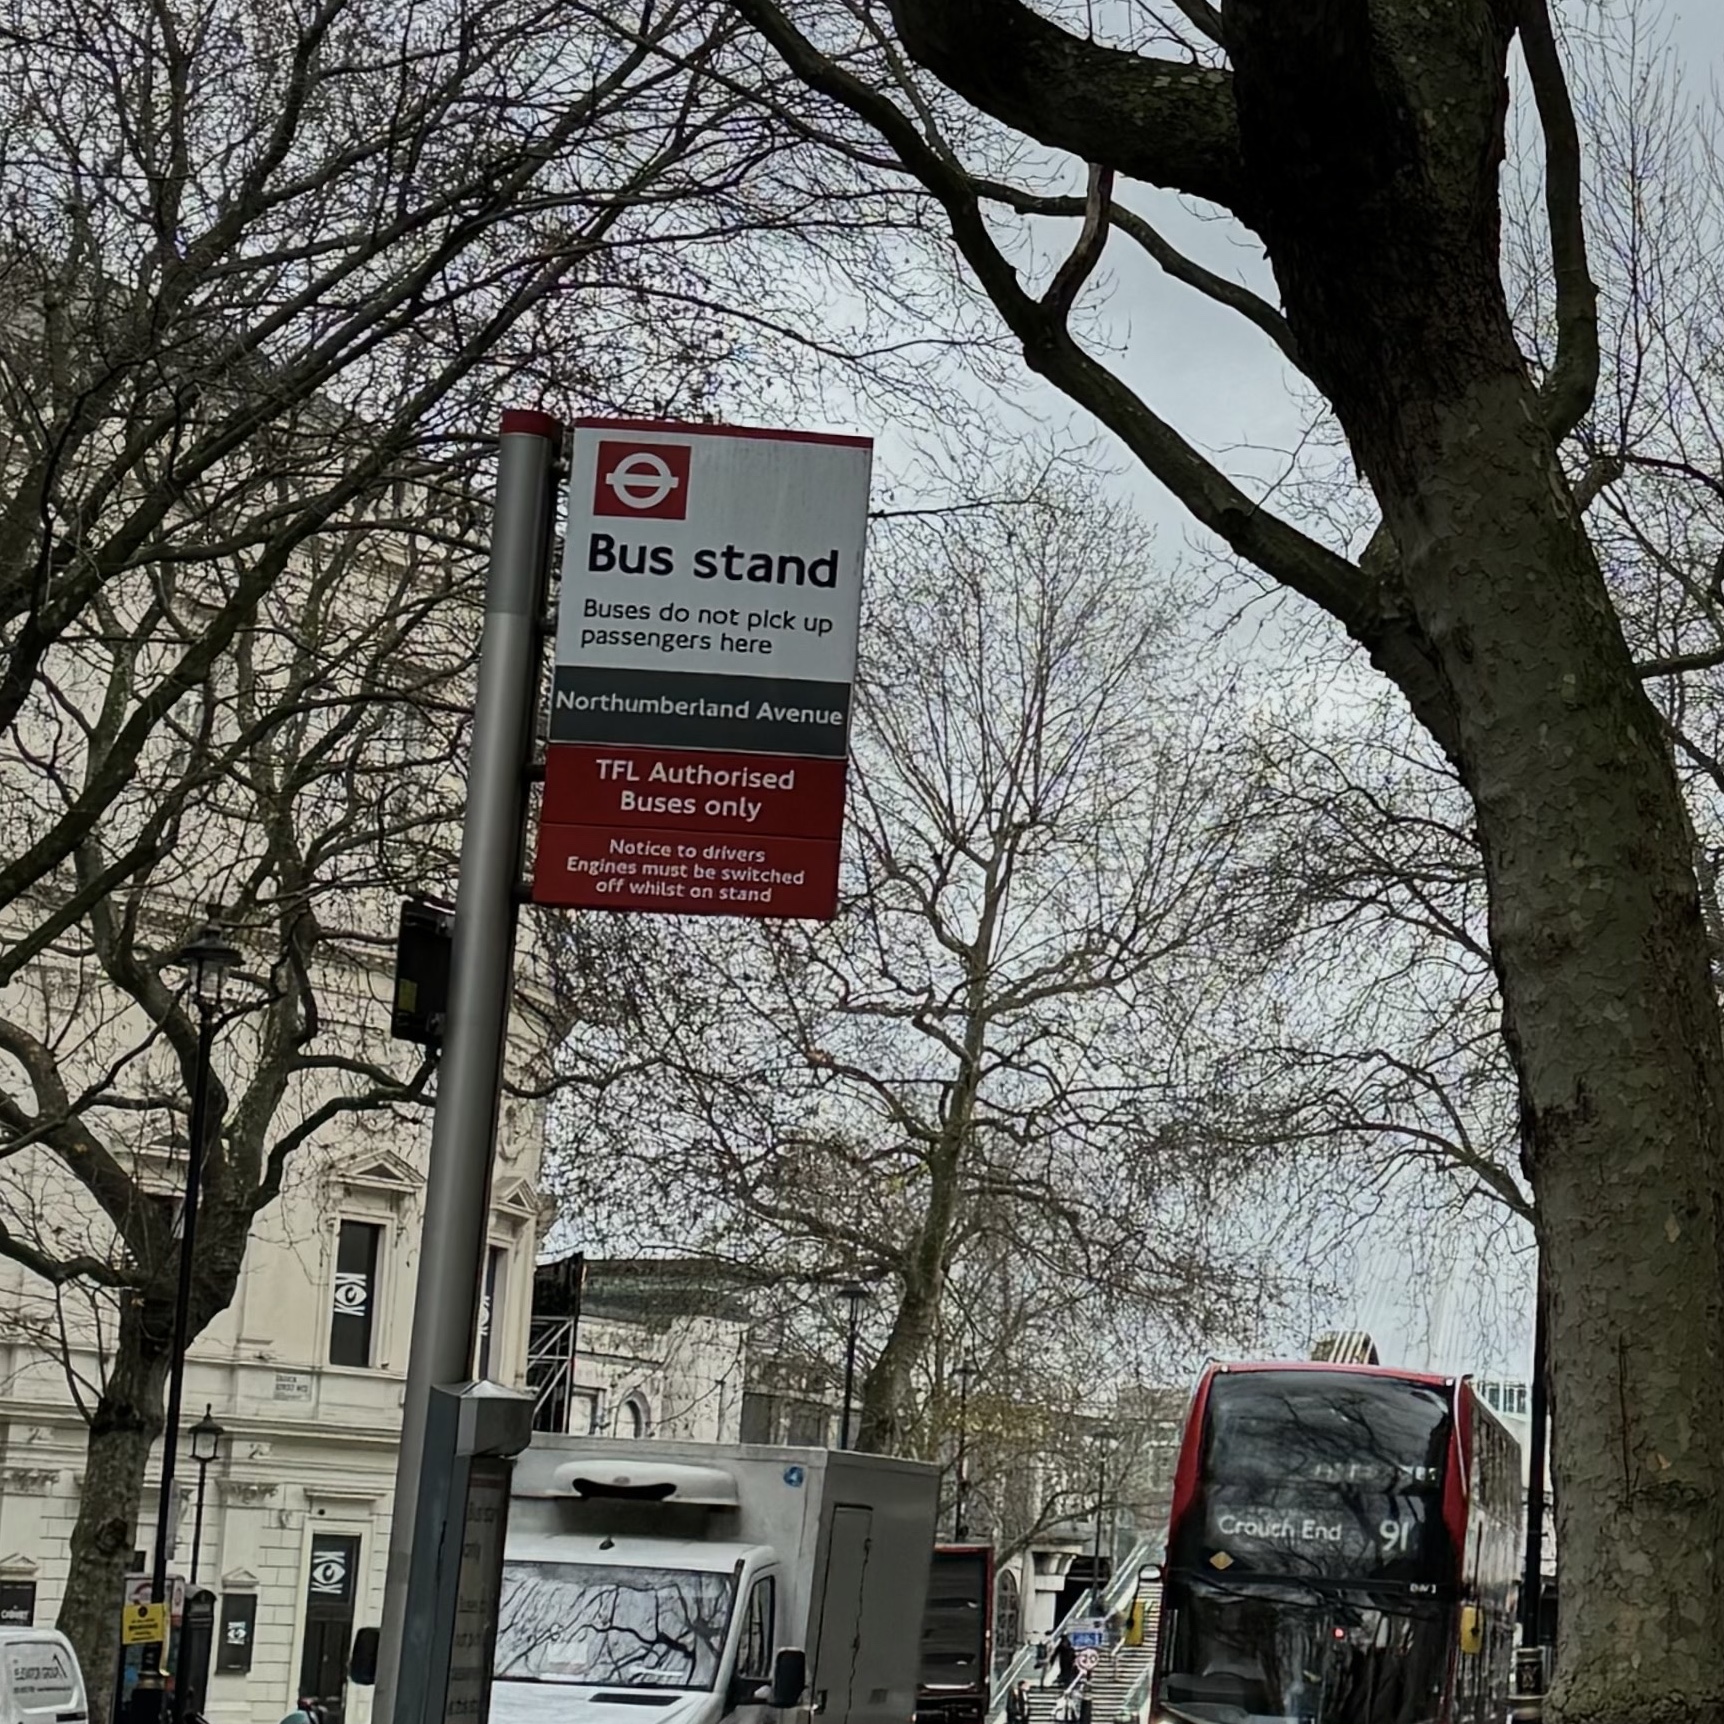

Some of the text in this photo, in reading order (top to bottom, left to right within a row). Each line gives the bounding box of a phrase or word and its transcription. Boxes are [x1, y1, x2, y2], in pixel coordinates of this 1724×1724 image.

[588, 533, 839, 588] Bus stand
[584, 599, 833, 635] Buses do not pick up
[580, 628, 772, 654] passengers here
[556, 691, 842, 725] Northumberland Avenue
[597, 760, 795, 790] TFL Authorised
[621, 791, 762, 821] Buses only
[610, 839, 765, 863] Notice to drivers
[567, 857, 804, 885] Engines must be switched
[596, 878, 772, 903] off whilst on stand
[1218, 1515, 1409, 1551] Crouch End 91
